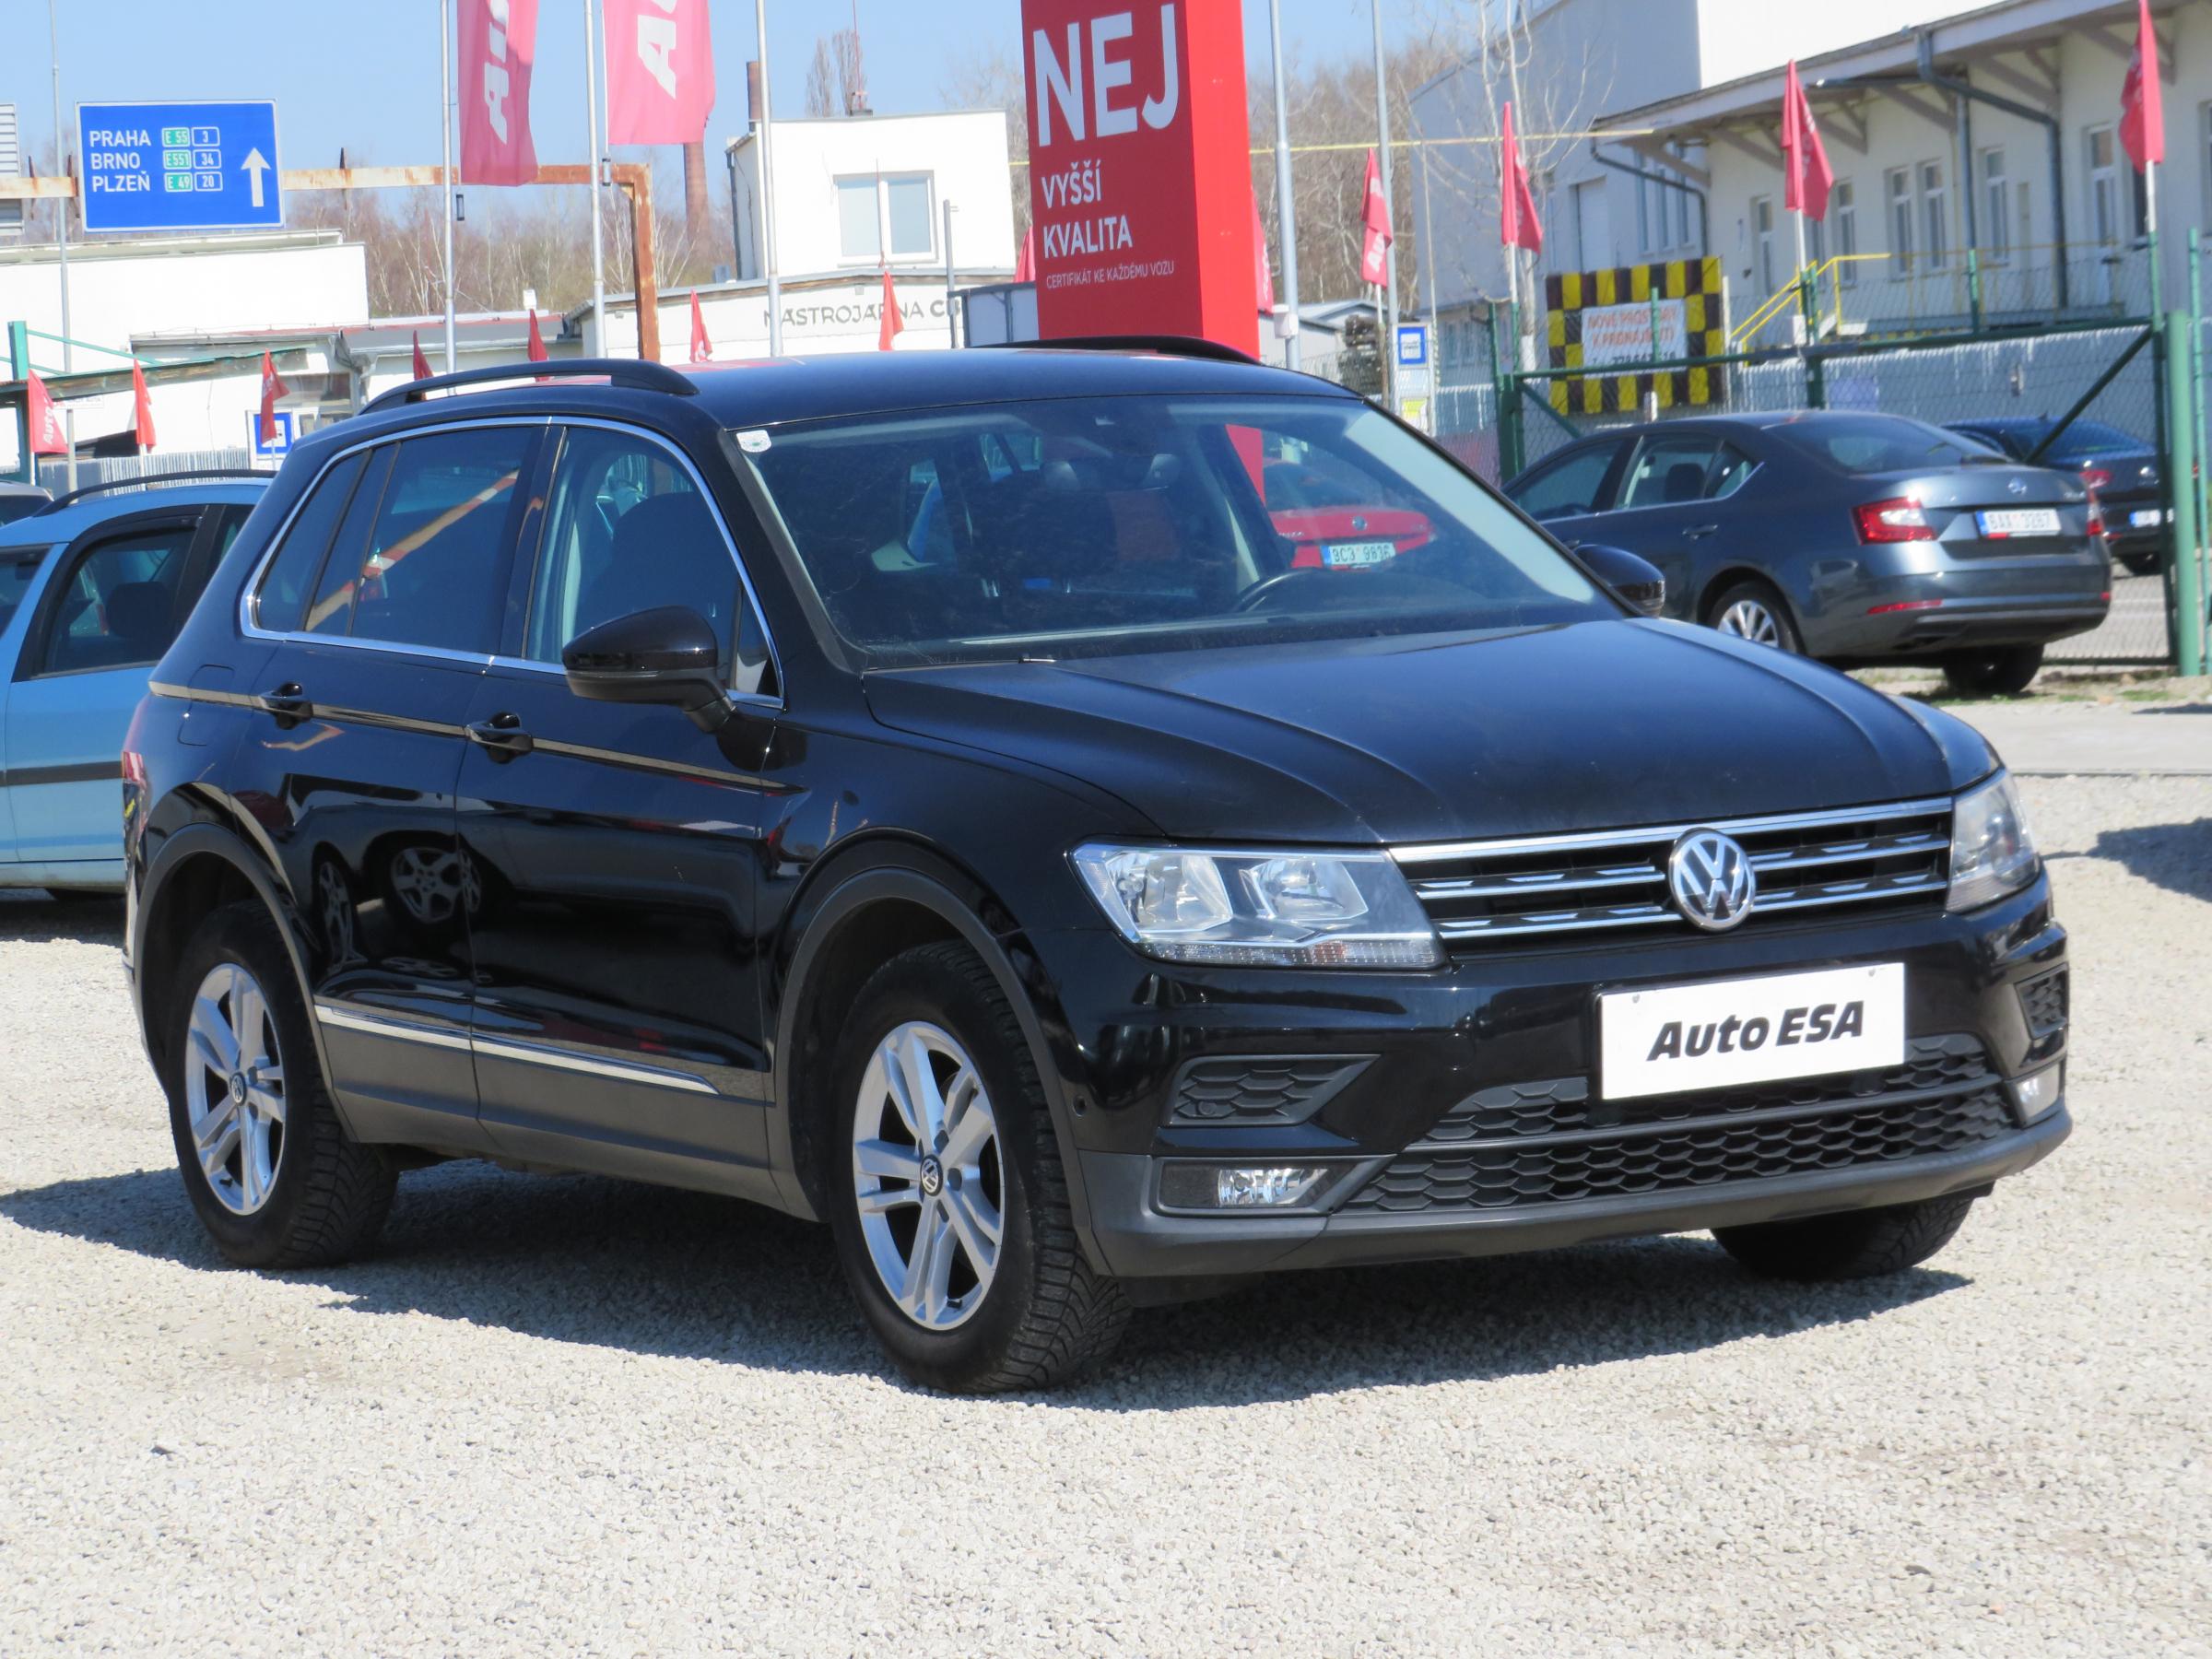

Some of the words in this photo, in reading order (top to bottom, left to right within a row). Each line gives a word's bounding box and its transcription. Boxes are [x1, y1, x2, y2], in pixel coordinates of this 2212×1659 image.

[1032, 3, 1179, 147] NEJ
[88, 130, 151, 147] PRAHA
[202, 131, 209, 144] 3
[90, 152, 141, 170] BRNO
[201, 153, 214, 166] 34
[92, 171, 151, 193] PLZEŇ
[202, 175, 214, 188] 20
[1041, 159, 1101, 209] VYŠŠÍ
[1042, 214, 1133, 259] KVALITA
[1046, 267, 1091, 289] CERTIFIKÁT
[1093, 268, 1105, 284] KE
[1106, 263, 1148, 281] KAŽDÉMU
[1149, 260, 1175, 276] VOZU
[1646, 1014, 1770, 1062] Auto
[1775, 1000, 1865, 1047] ESA
